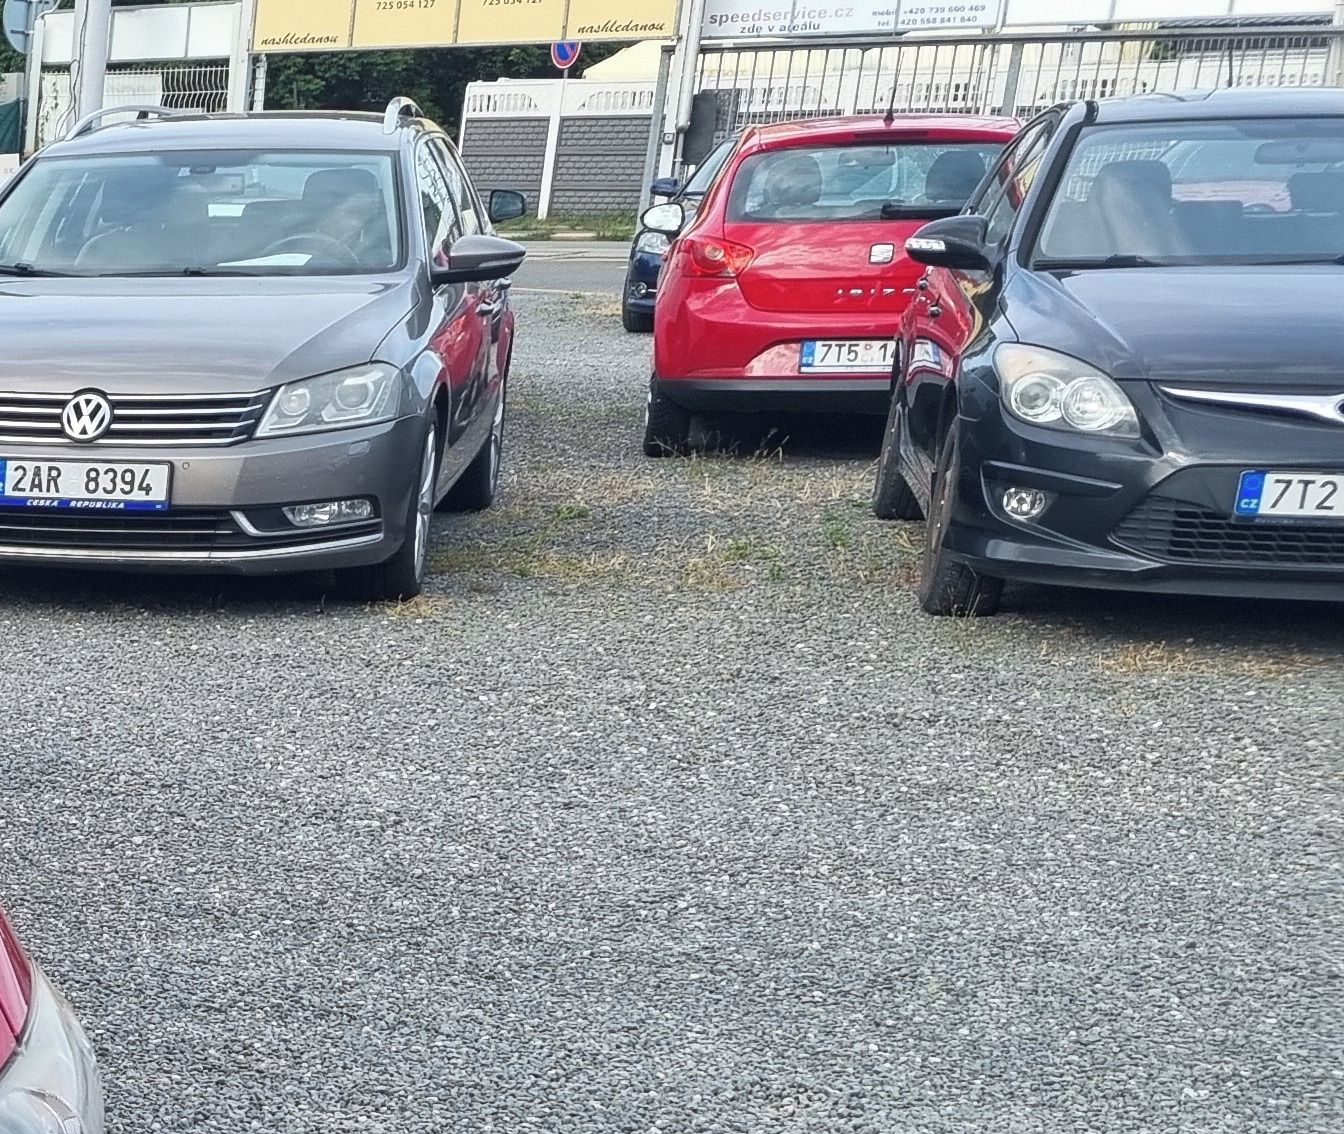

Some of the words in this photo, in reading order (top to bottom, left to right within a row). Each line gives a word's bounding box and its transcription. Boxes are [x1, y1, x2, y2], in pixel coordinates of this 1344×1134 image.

[375, 1, 394, 10] 725
[396, 0, 414, 9] 054
[709, 7, 855, 26] speedservice.cz
[577, 19, 666, 34] nashledanou
[739, 24, 763, 34] zde
[261, 32, 339, 46] nashledanou
[820, 343, 860, 364] 7T5
[12, 464, 62, 494] 2AR
[84, 467, 153, 497] 8394
[1269, 478, 1339, 511] 7T2
[69, 500, 125, 509] REPUBLIKA
[1240, 498, 1259, 509] CZ
